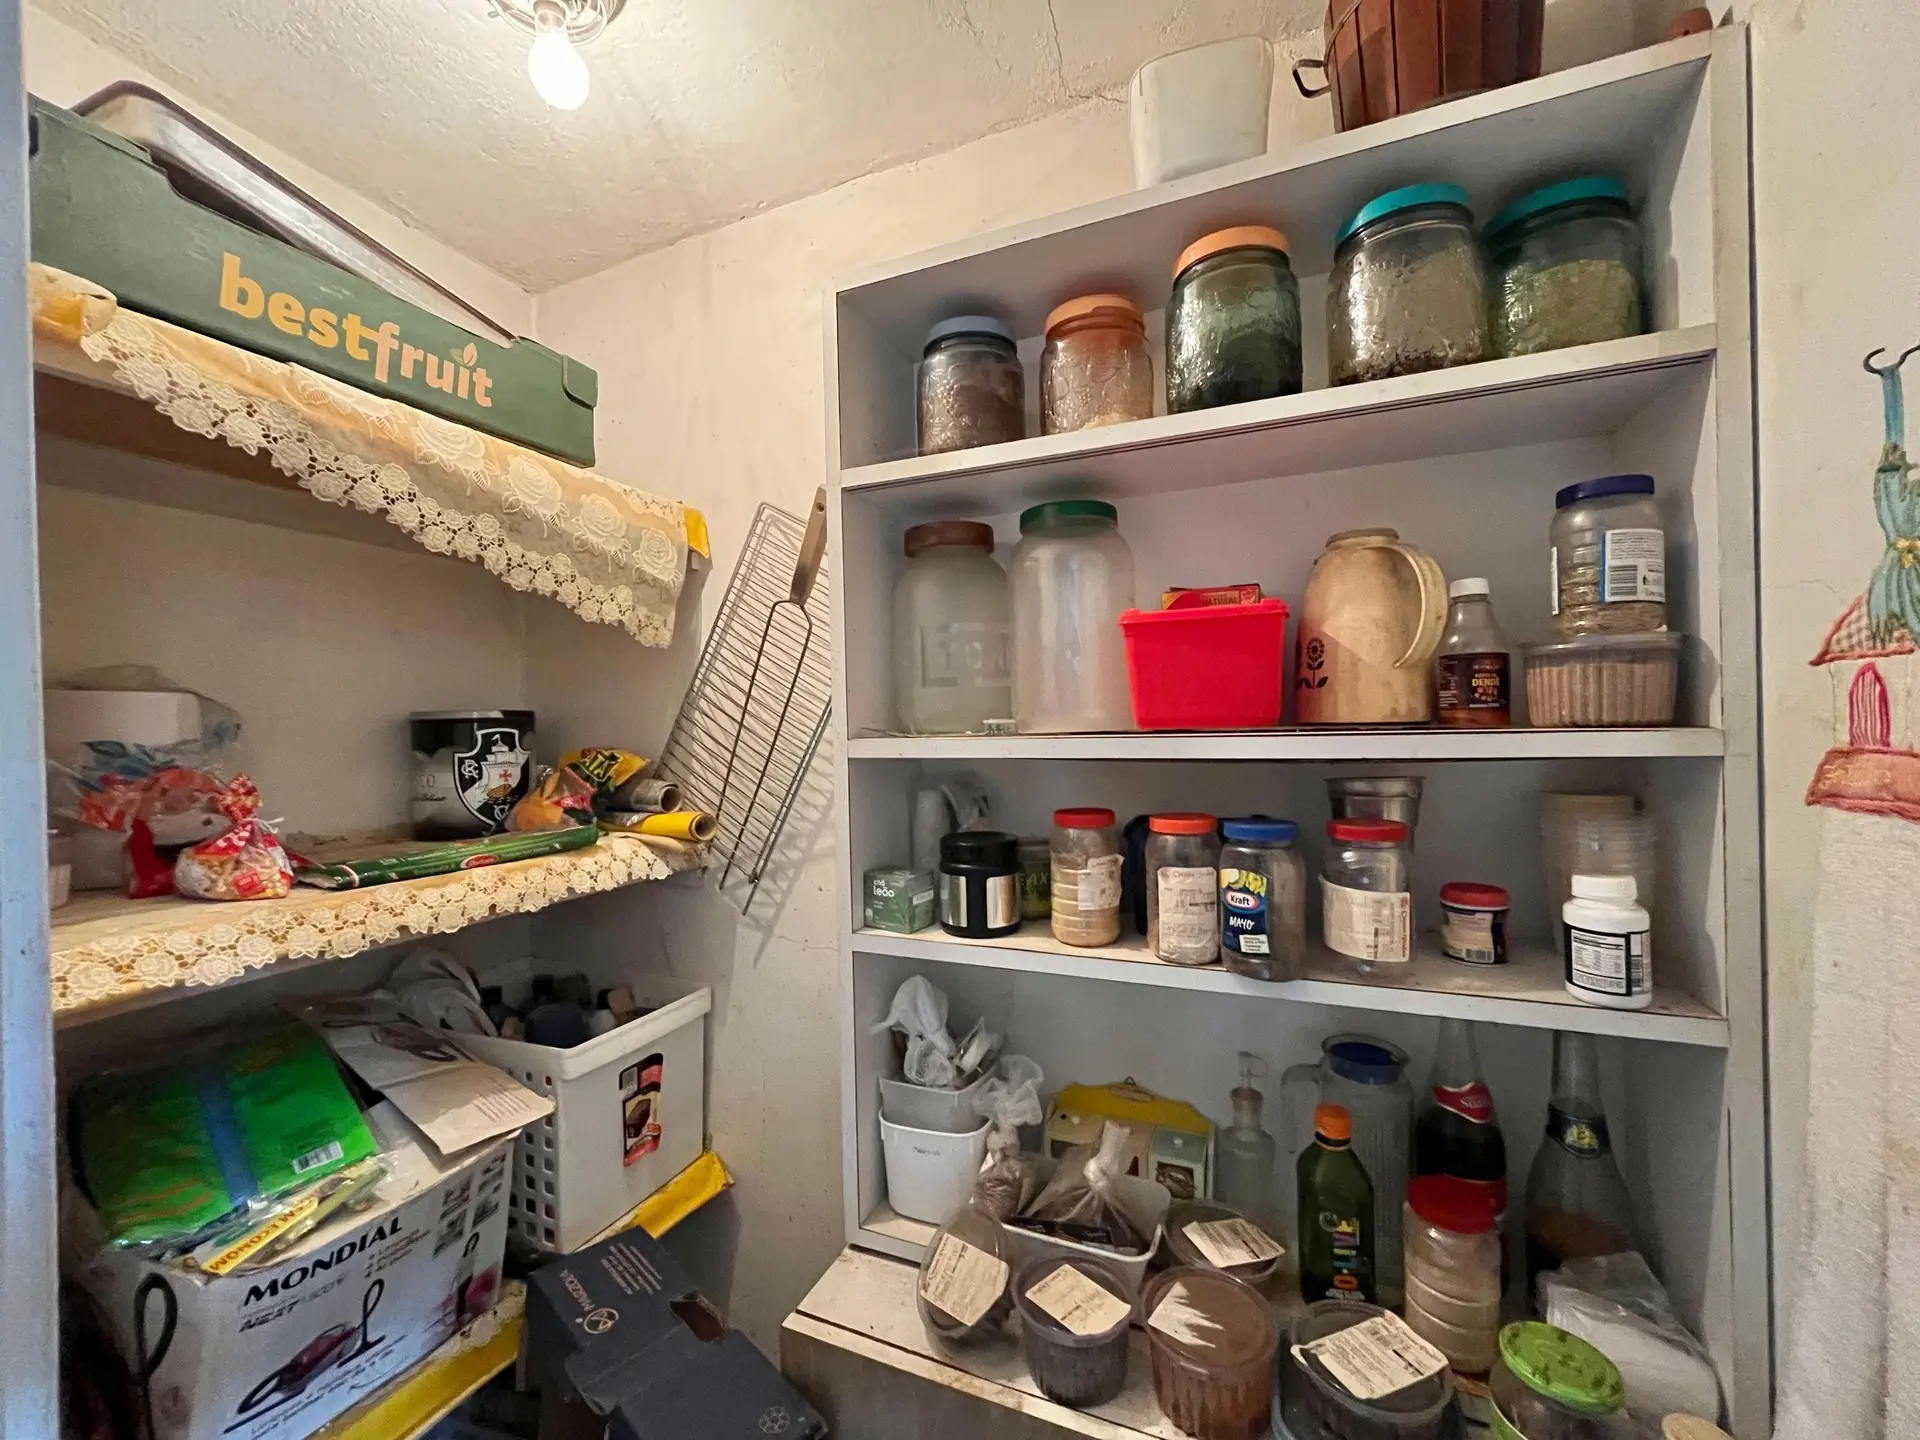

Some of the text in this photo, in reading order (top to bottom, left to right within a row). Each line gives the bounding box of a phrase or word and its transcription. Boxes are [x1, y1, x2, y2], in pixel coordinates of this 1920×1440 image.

[220, 253, 493, 408] bestfruit
[1229, 915, 1255, 931] MAYO
[1230, 894, 1250, 906] Kraft
[244, 1216, 402, 1307] MONDIAL
